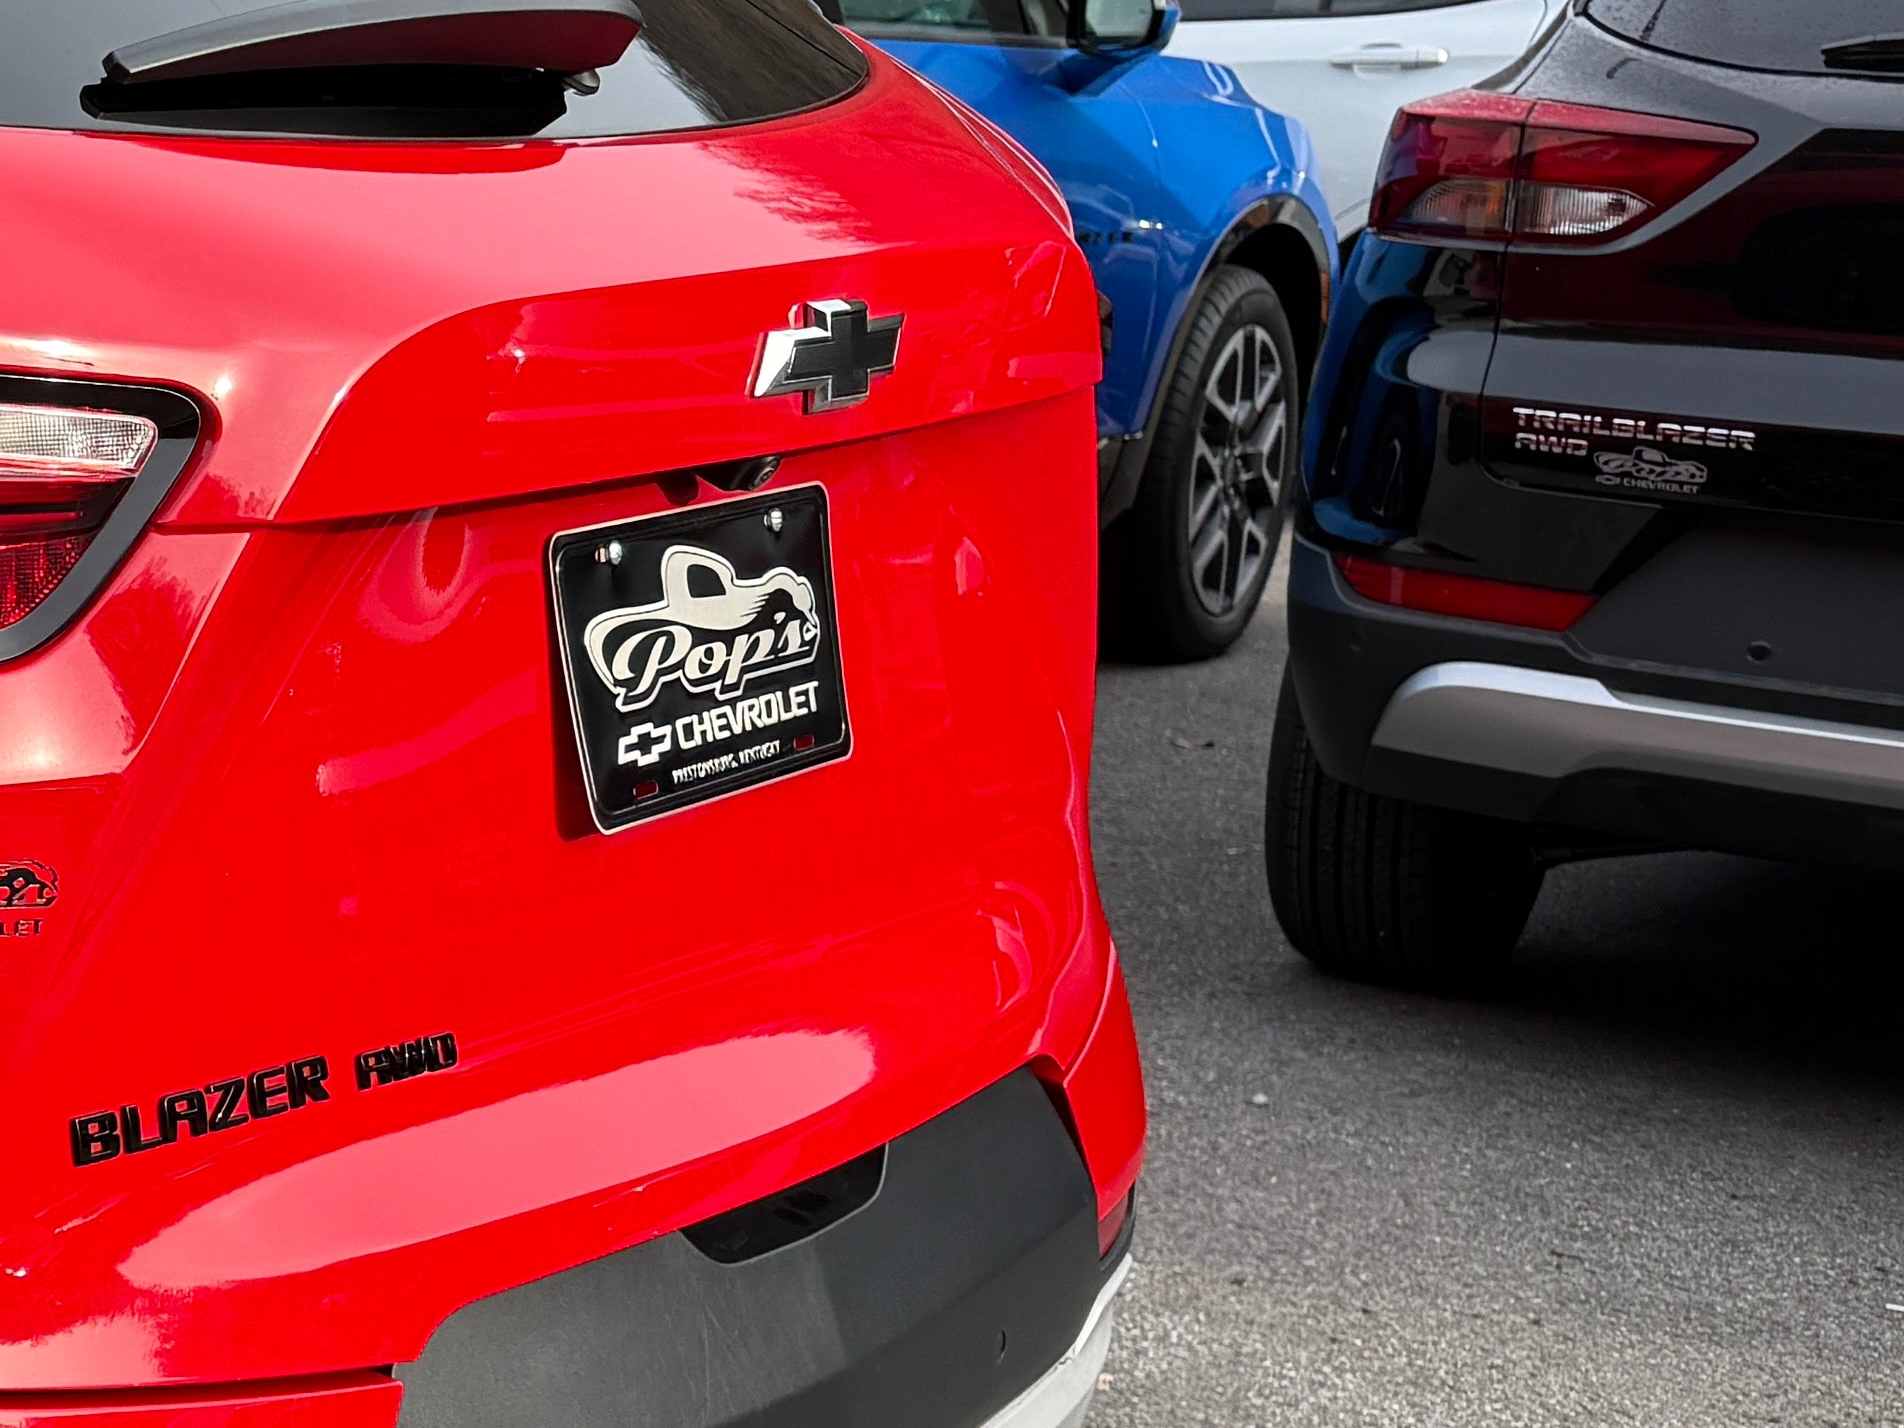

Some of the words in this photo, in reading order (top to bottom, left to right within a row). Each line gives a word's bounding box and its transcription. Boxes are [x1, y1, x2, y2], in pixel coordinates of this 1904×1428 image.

[1513, 406, 1757, 451] TRAILBLAZER
[1515, 432, 1588, 457] AWD
[611, 611, 814, 696] Pop's
[676, 681, 820, 751] CHEVROLET
[69, 1055, 330, 1167] BLAZER
[355, 1031, 458, 1091] AWD
